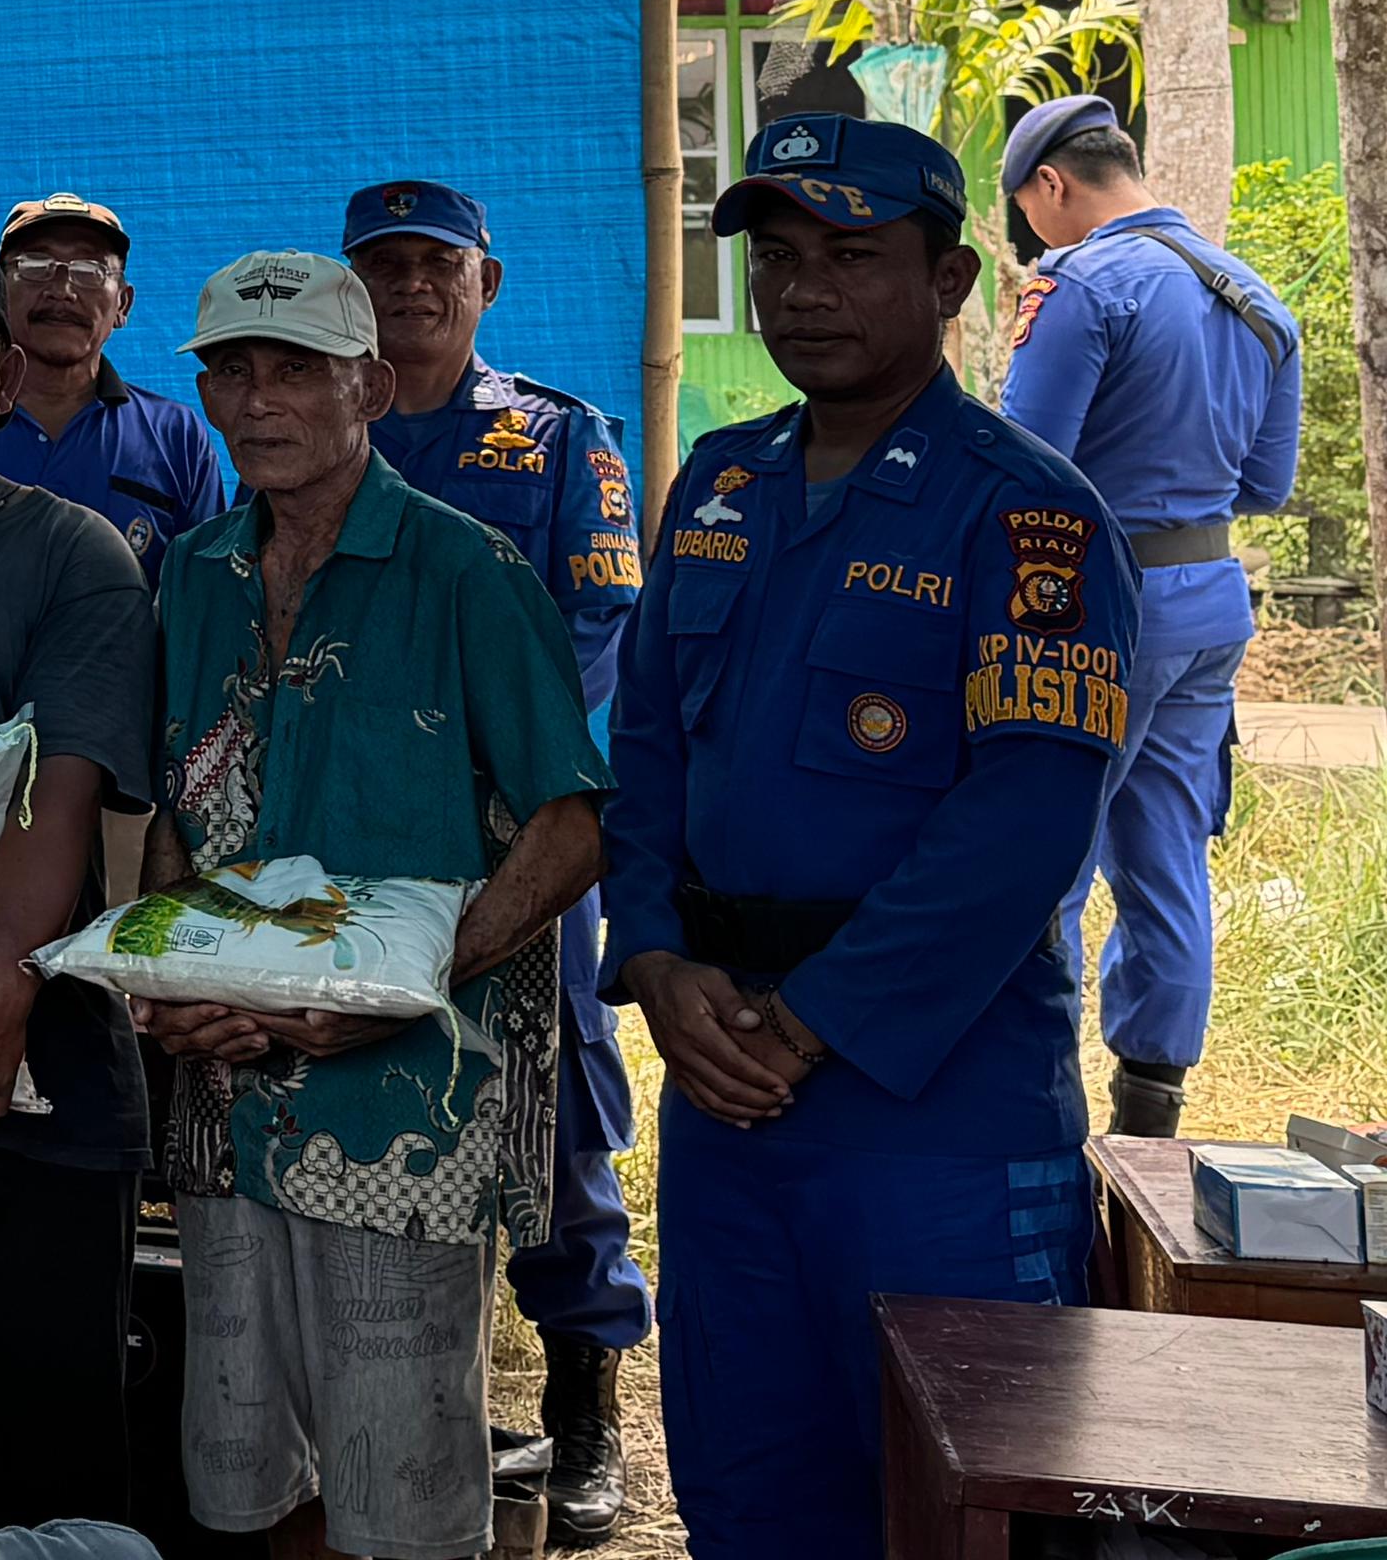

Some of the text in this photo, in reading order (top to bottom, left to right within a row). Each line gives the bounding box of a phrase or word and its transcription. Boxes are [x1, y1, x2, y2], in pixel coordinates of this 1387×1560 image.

[458, 448, 545, 474] POLRI
[1008, 511, 1084, 537] POLDA
[1019, 538, 1078, 555] RIAU
[843, 561, 953, 608] POLRI
[979, 634, 1010, 666] KP
[965, 662, 1078, 733] POLISI
